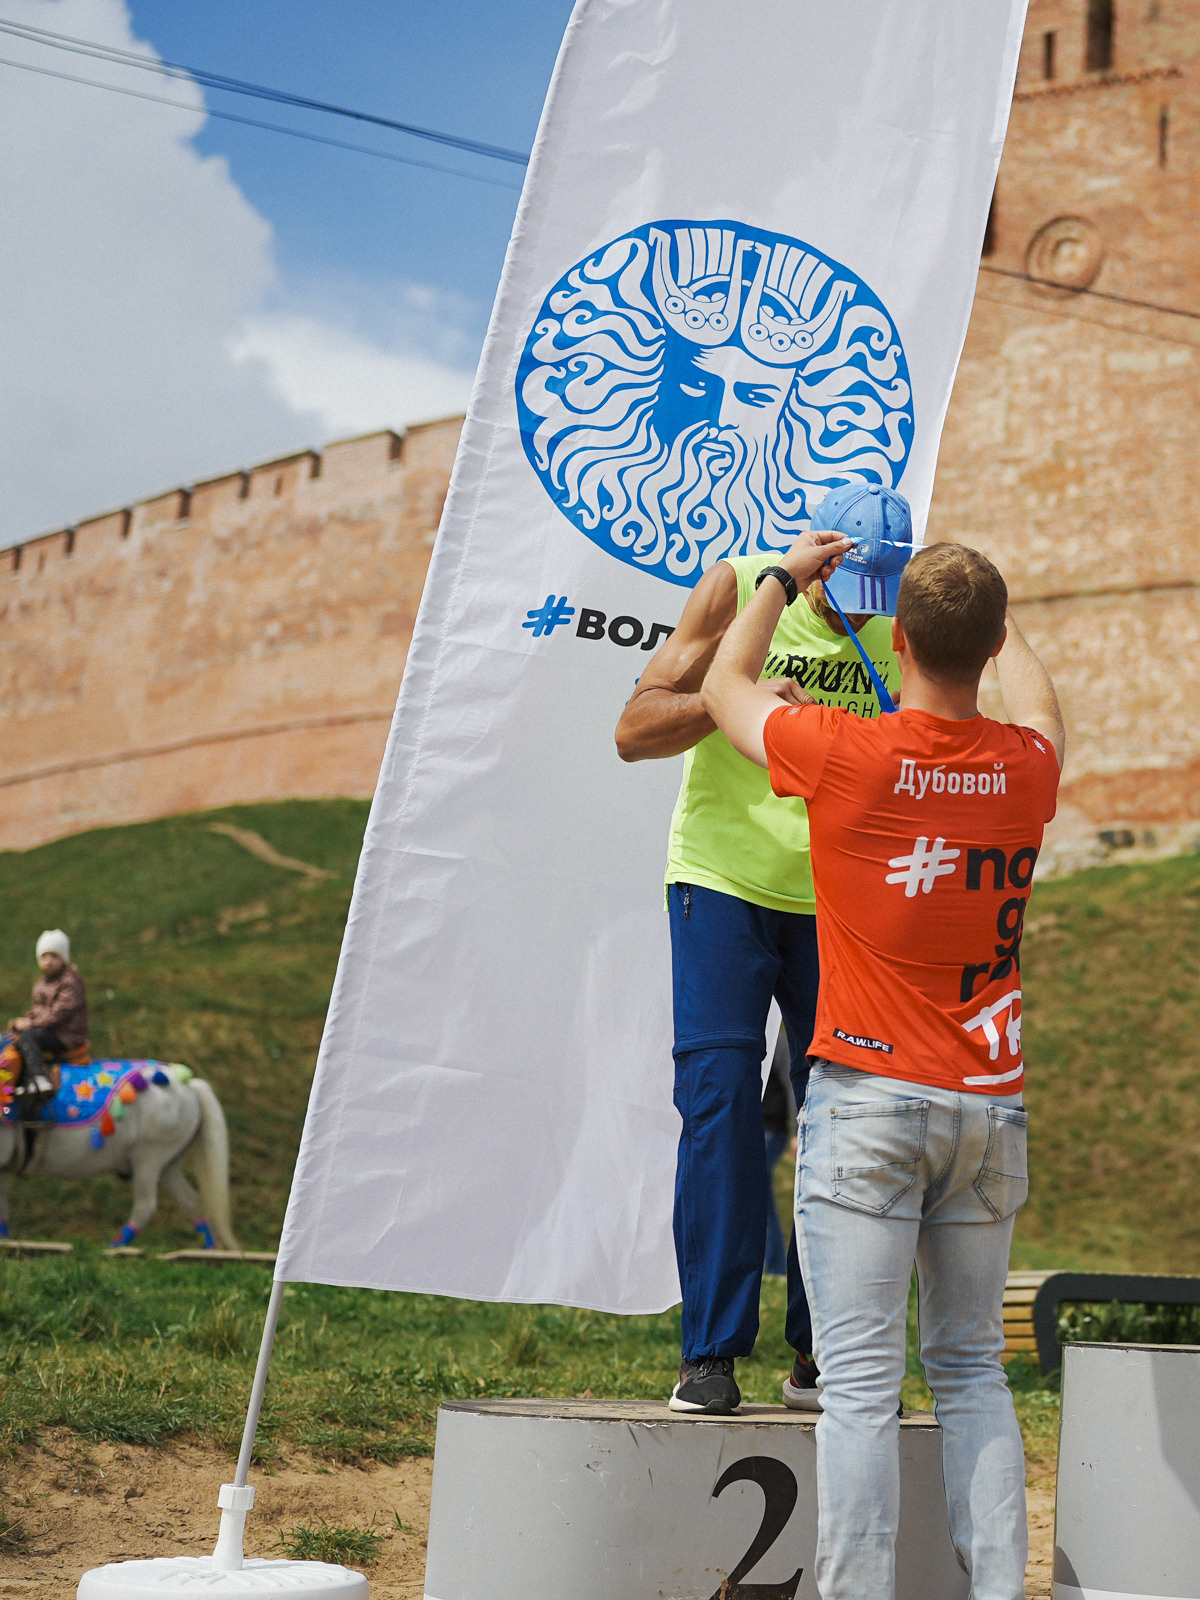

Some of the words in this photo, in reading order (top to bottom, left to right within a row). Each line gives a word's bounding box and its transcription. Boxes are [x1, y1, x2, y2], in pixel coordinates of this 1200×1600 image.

[781, 654, 874, 695] RUN
[893, 758, 1007, 800] Дубовой
[836, 1030, 890, 1053] R.A.W.LIFE
[708, 1455, 804, 1600] 2
